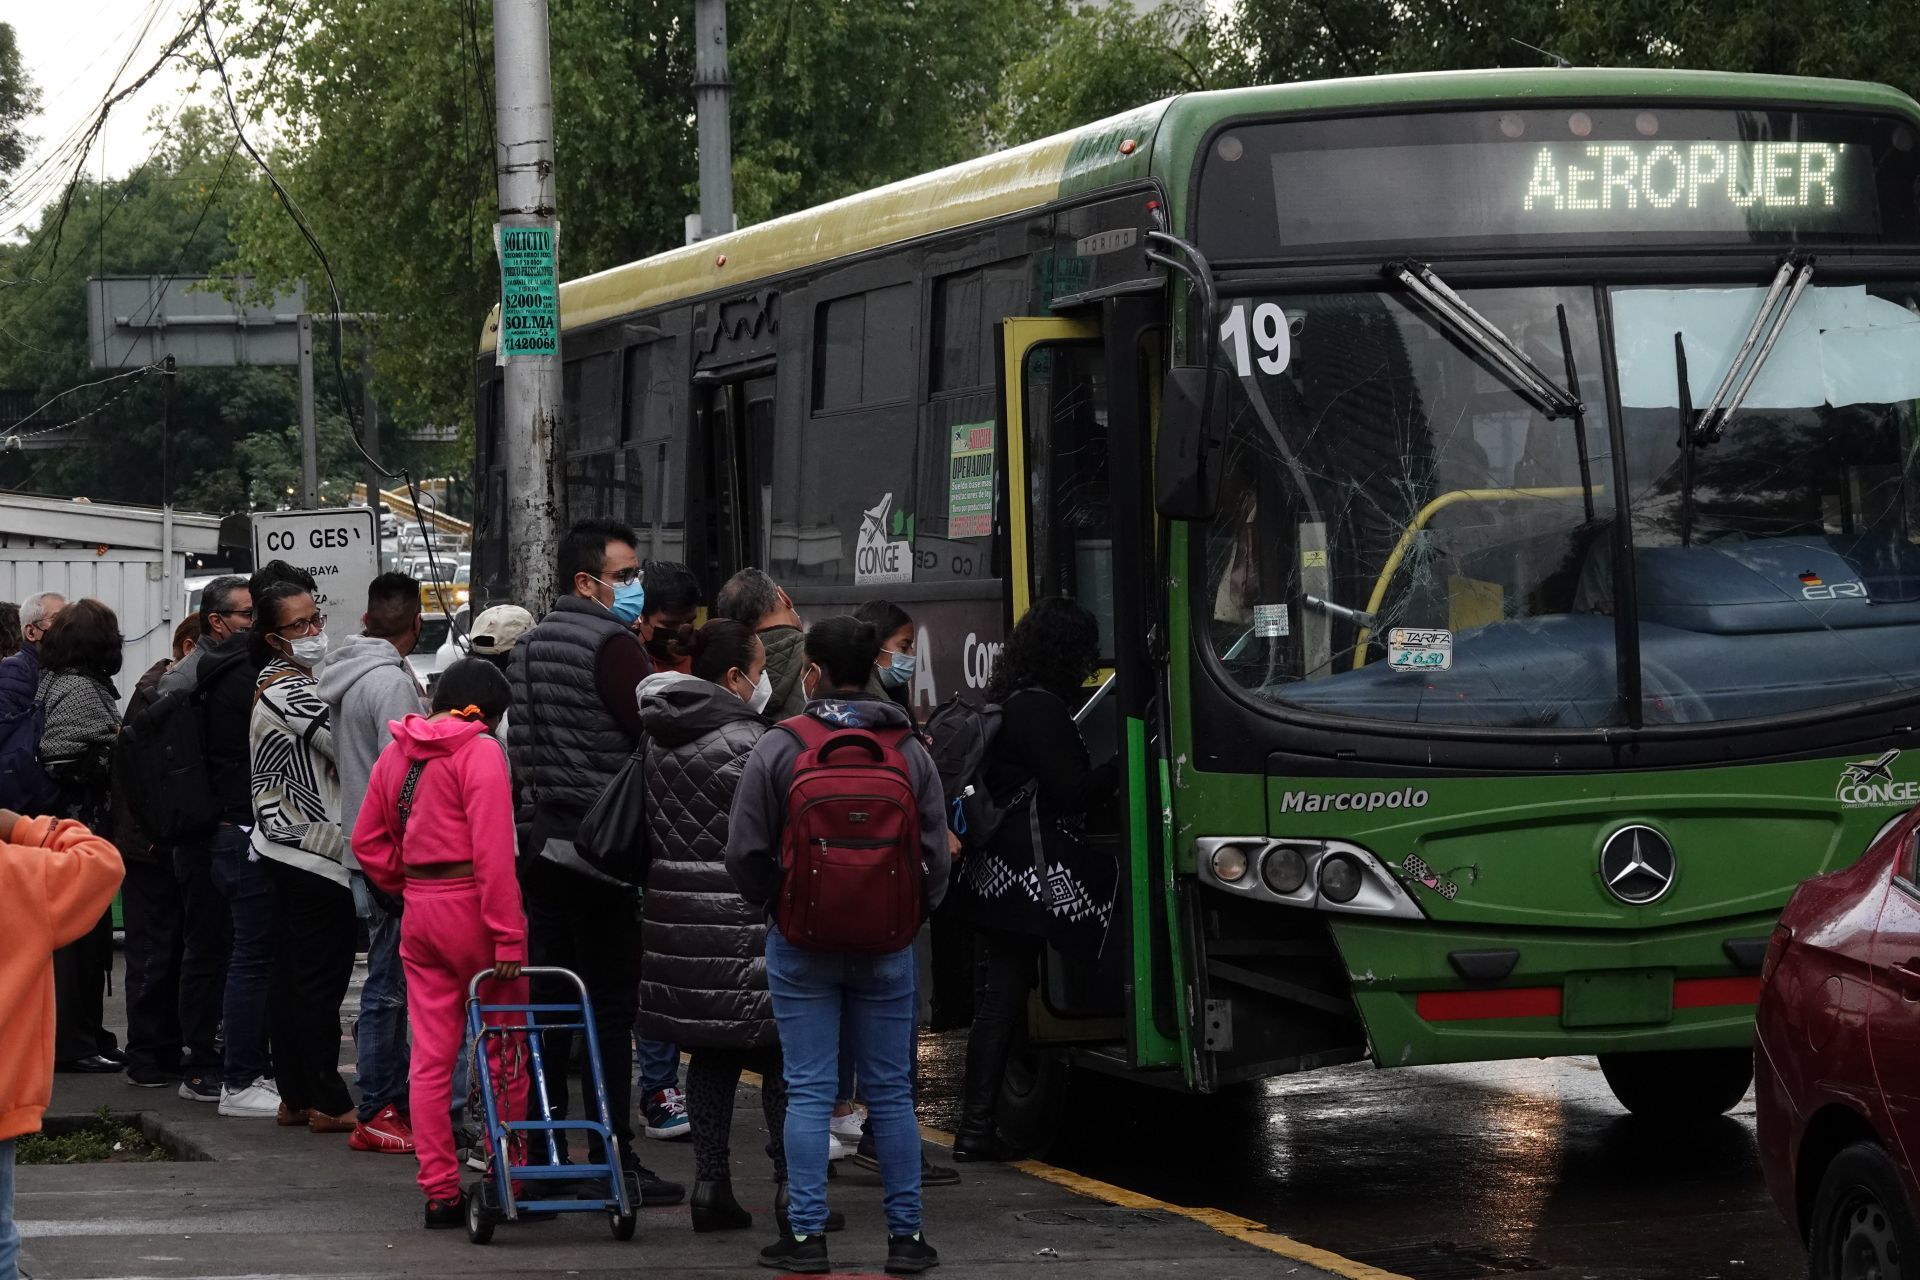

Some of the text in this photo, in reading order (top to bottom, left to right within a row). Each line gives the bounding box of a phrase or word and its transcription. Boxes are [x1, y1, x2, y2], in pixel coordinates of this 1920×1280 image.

[1524, 144, 1844, 210] AEROPUER
[504, 231, 550, 251] SOLICITO
[1083, 232, 1129, 253] TORINO
[505, 293, 542, 309] $2000
[505, 316, 554, 330] SOLMA
[505, 337, 555, 350] 71420068
[1220, 302, 1291, 377] 19
[952, 453, 992, 480] OPERADOR
[858, 545, 899, 575] CONGE
[1406, 632, 1450, 643] TARIFA
[1280, 787, 1429, 813] Marcopolo
[1840, 781, 1920, 803] CONGE
